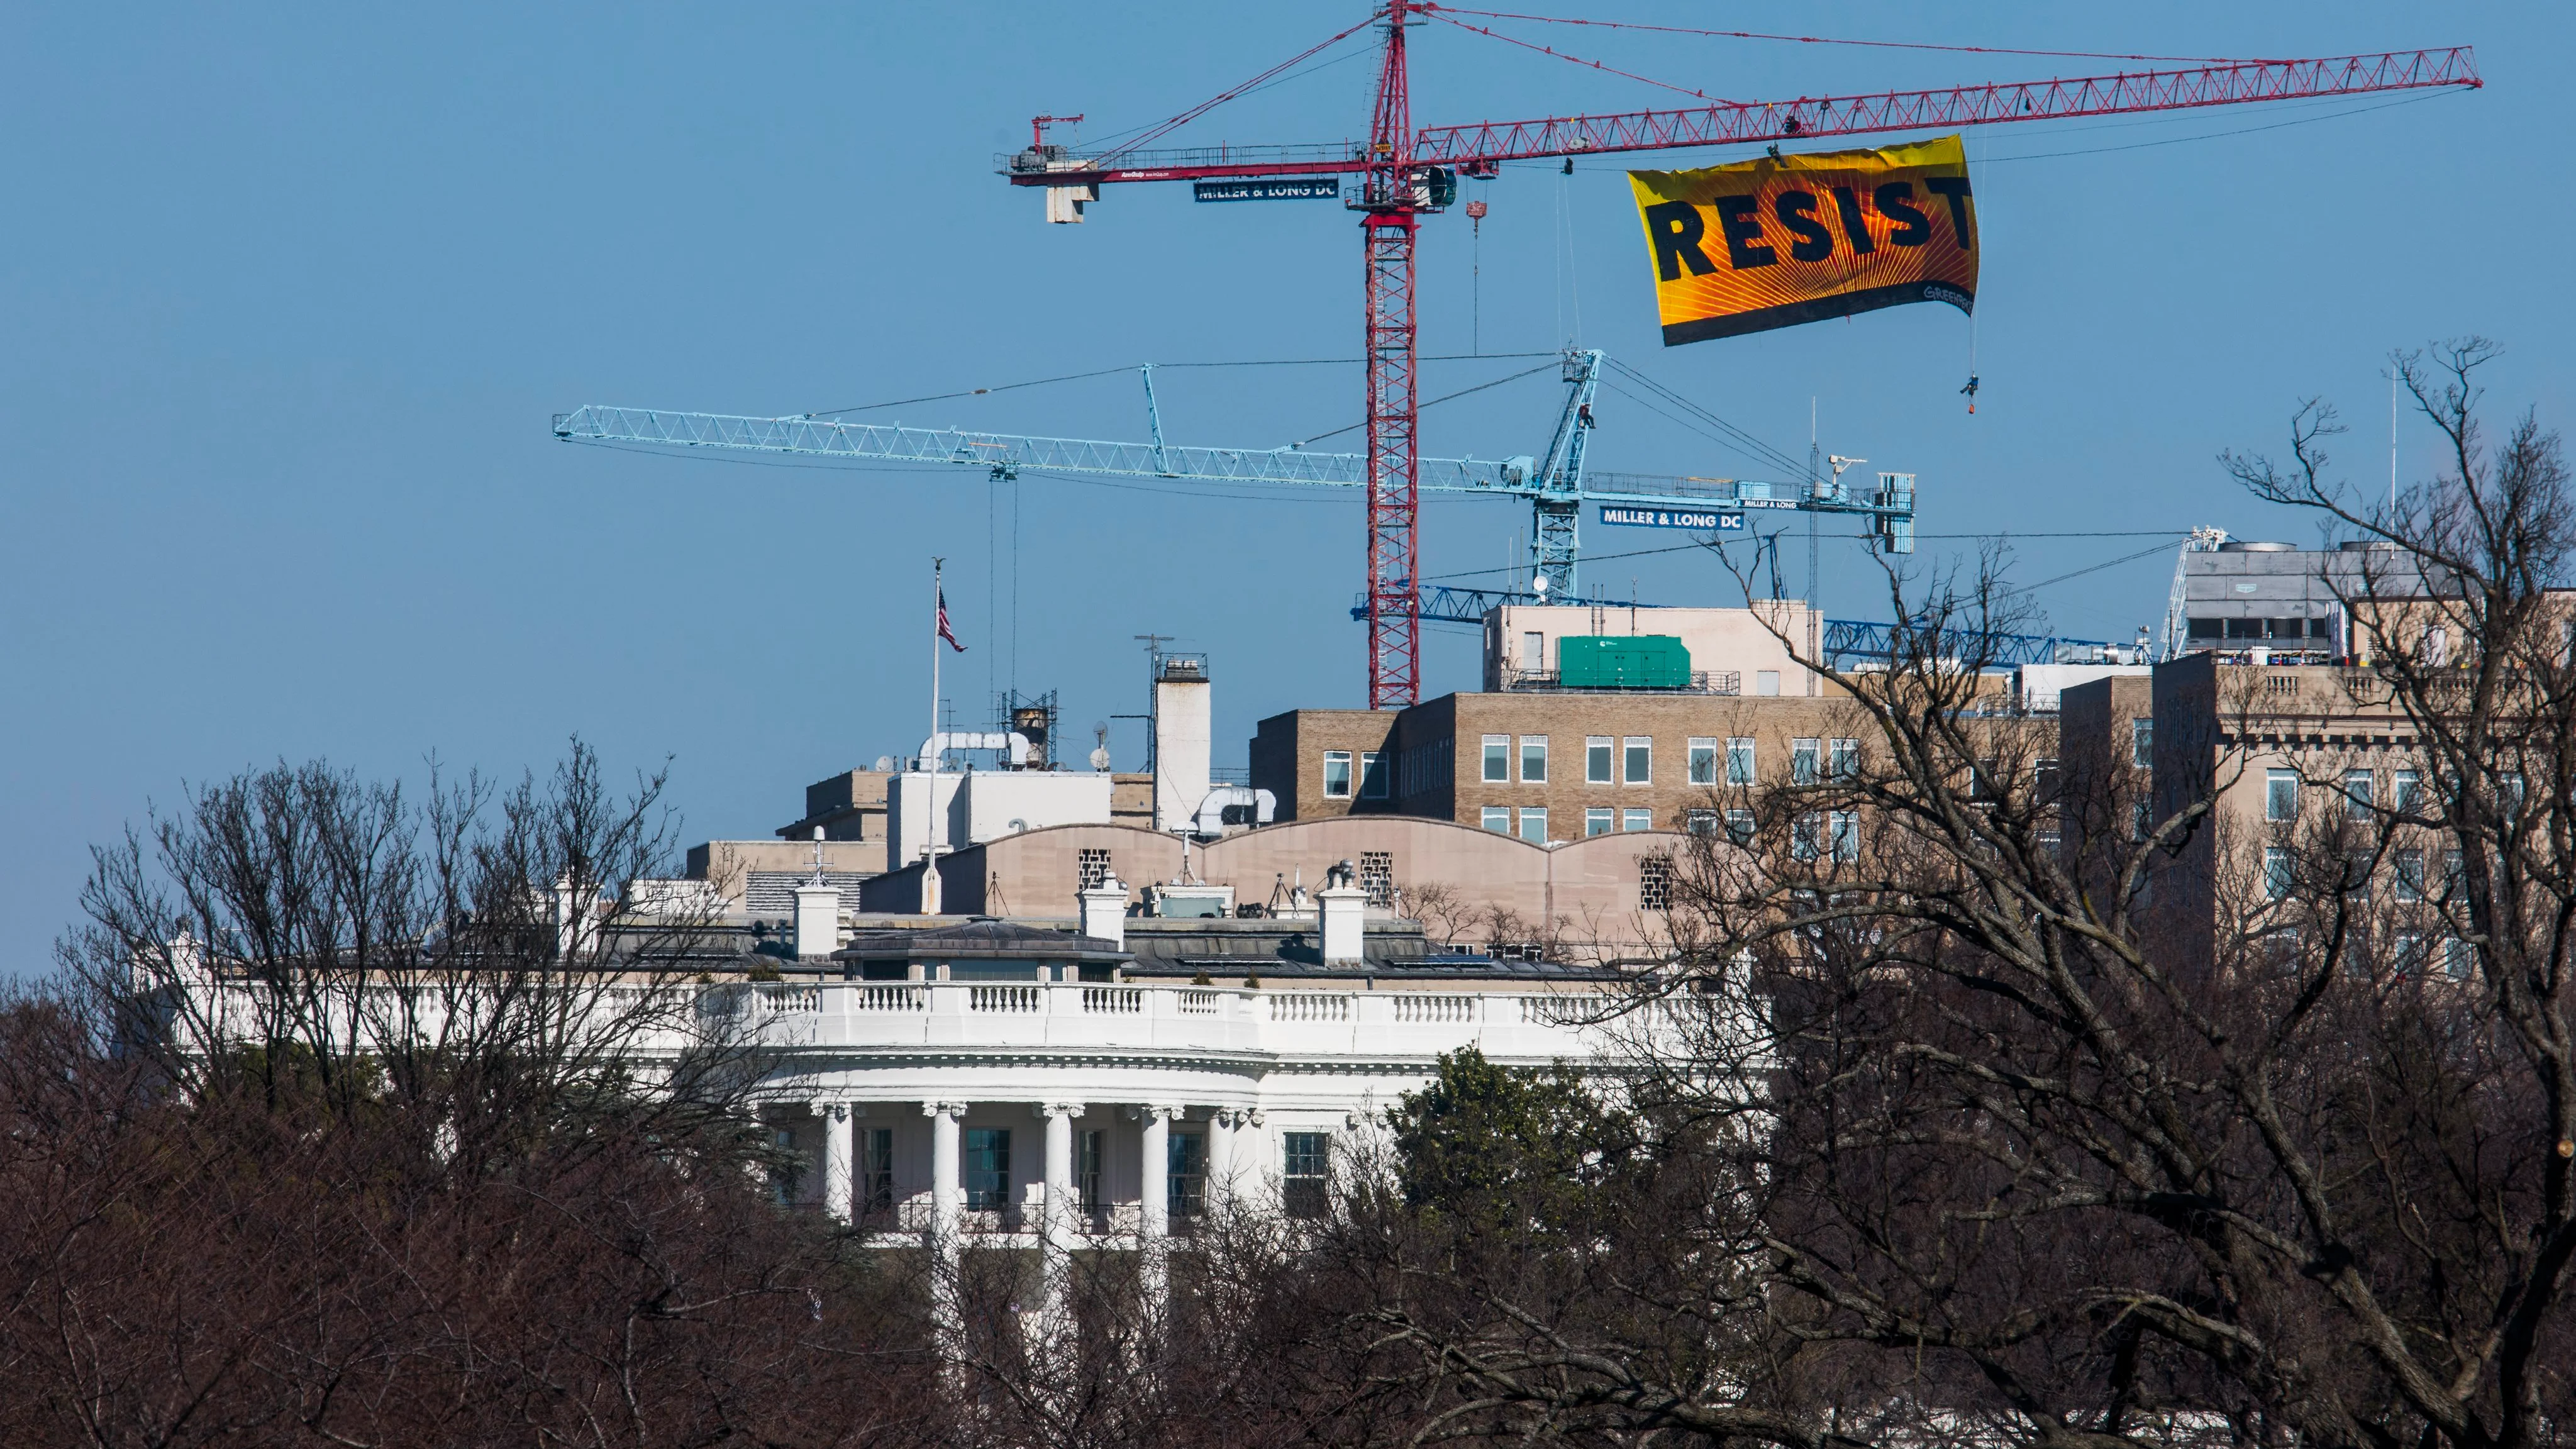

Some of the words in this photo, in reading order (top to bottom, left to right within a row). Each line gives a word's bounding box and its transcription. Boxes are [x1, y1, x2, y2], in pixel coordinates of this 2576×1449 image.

[1199, 186, 1248, 199] MILLER
[1252, 185, 1263, 197] &
[1268, 184, 1311, 196] LONG
[1315, 182, 1335, 196] DC
[1645, 177, 1972, 282] RESIST
[1604, 510, 1655, 525] MILLER
[1658, 513, 1670, 525] &
[1674, 514, 1716, 527] LONG
[1721, 516, 1741, 528] DC
